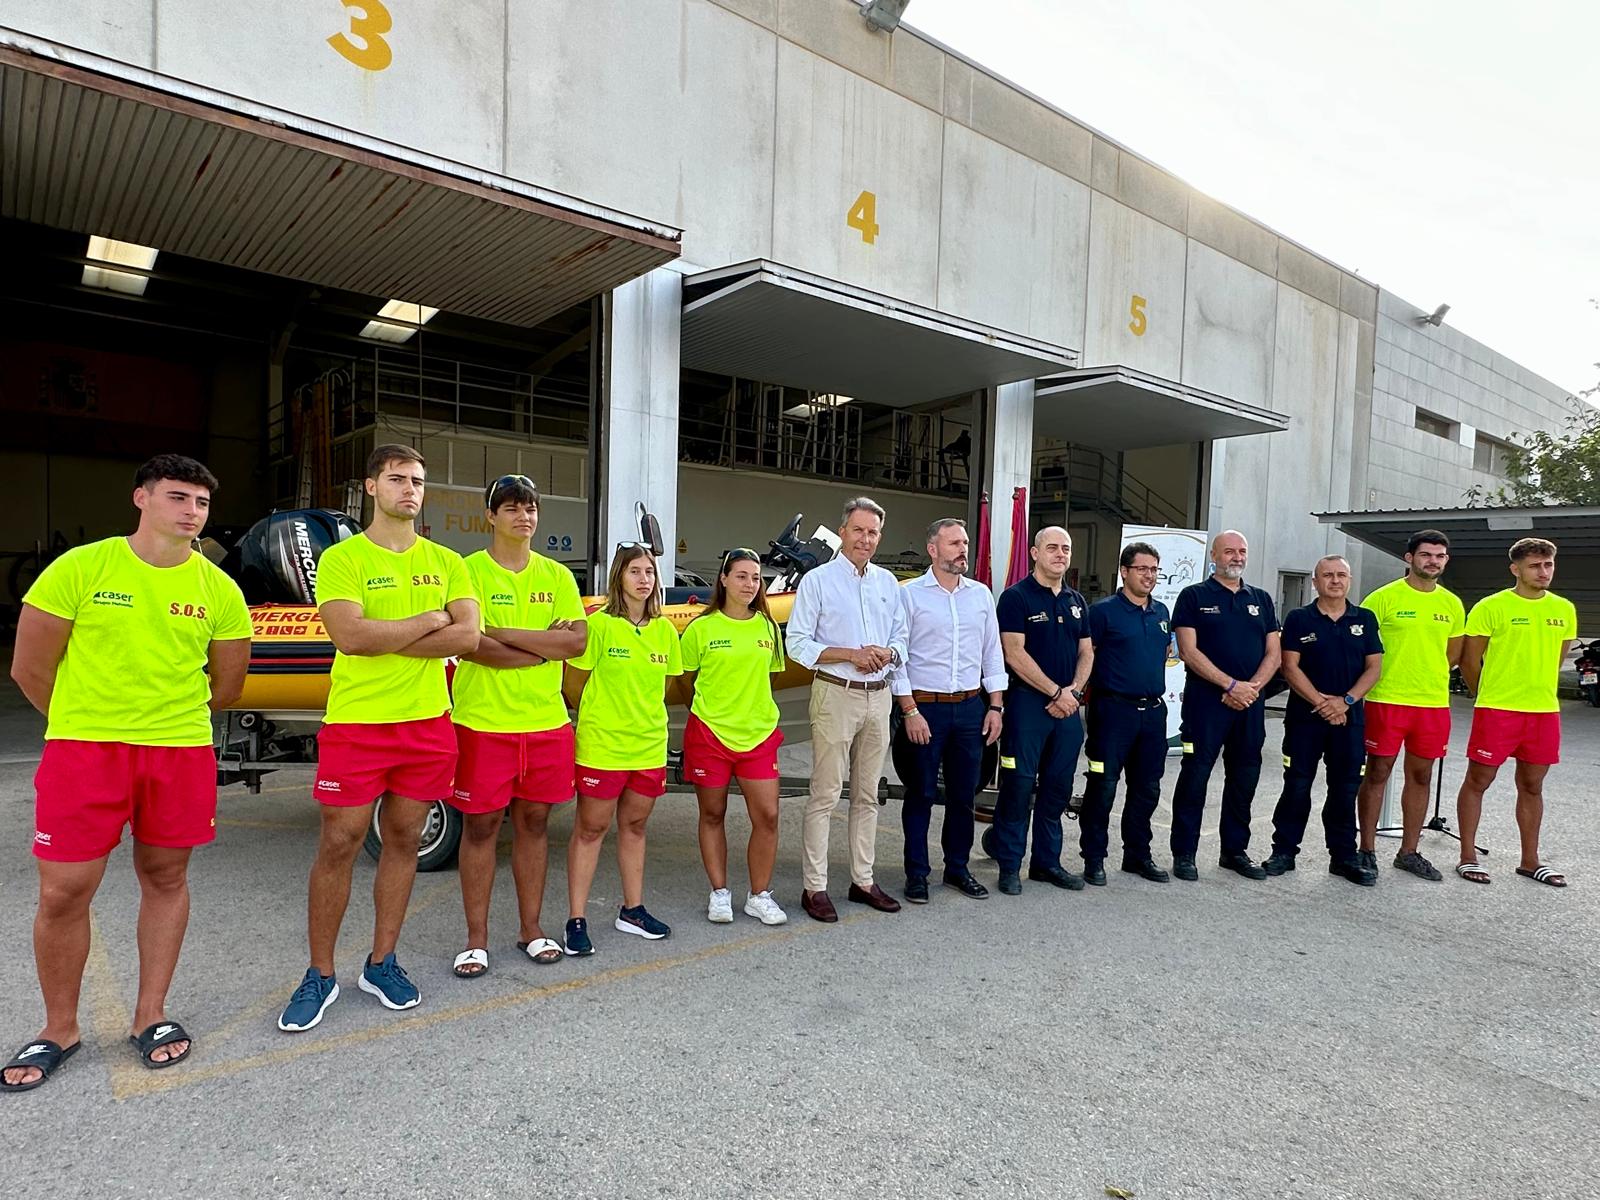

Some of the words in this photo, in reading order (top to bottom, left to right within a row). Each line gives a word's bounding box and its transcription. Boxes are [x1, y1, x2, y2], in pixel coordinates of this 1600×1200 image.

[326, 0, 393, 71] 3
[847, 190, 879, 245] 4
[1129, 295, 1147, 337] 5
[372, 577, 394, 585] caser
[412, 575, 443, 586] S.O.S.
[101, 591, 134, 602] caser
[170, 602, 207, 620] S.O.S.
